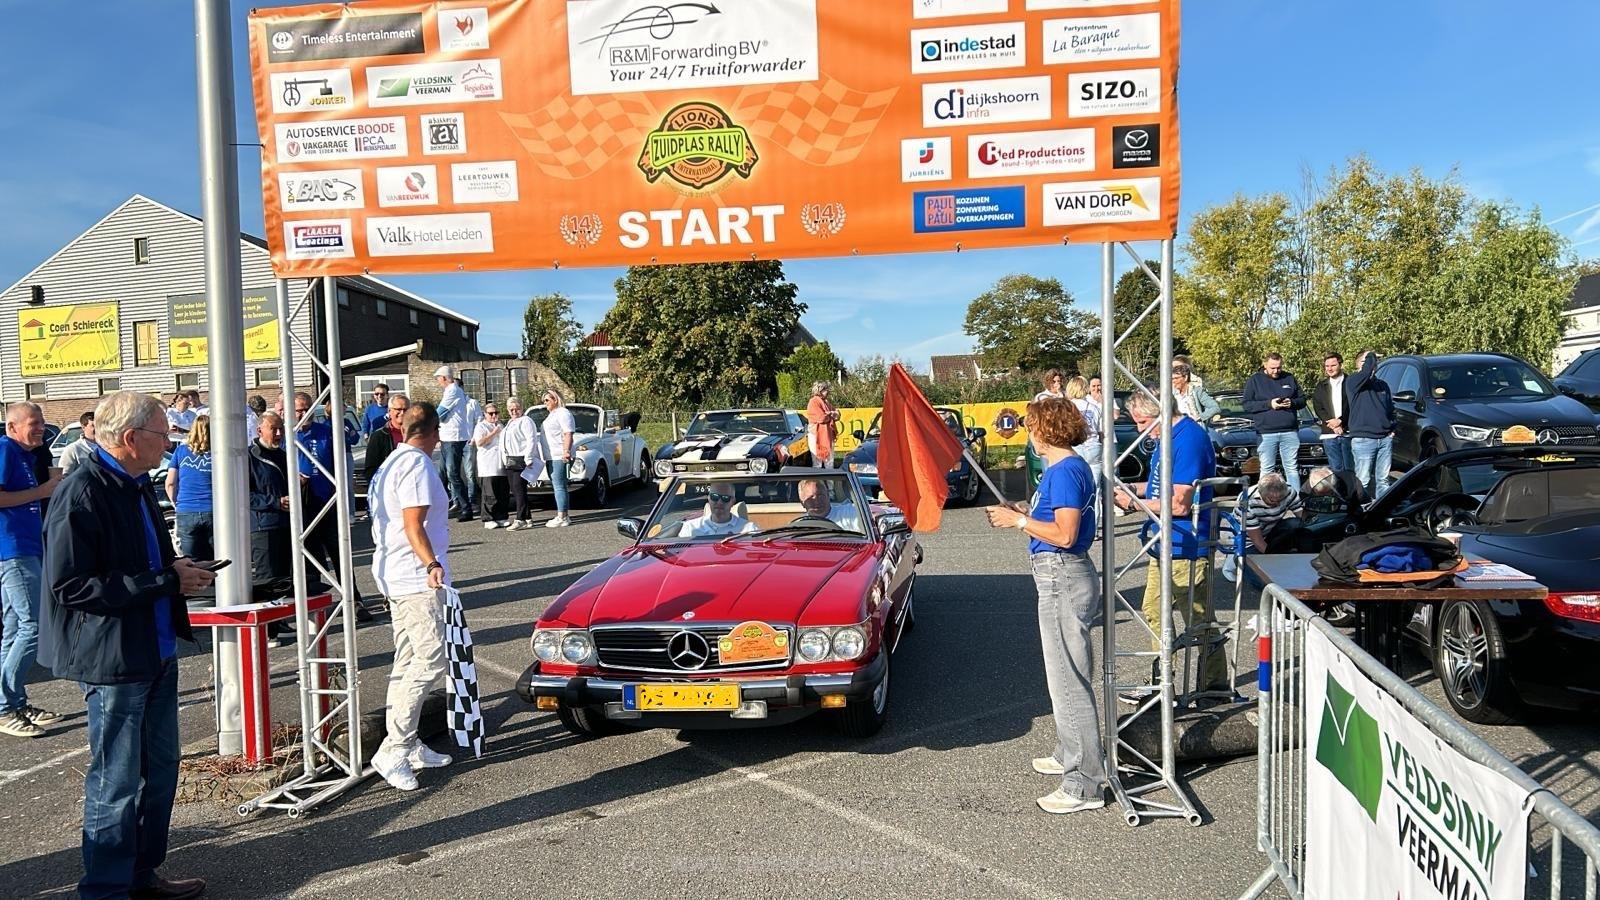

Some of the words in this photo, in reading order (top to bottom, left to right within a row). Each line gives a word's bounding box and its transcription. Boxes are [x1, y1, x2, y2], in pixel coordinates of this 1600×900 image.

[1064, 24, 1108, 33] Partycentrum
[302, 34, 344, 45] Timeless
[346, 28, 416, 41] Entertainment
[944, 34, 1016, 53] indestad
[1053, 40, 1067, 53] La
[1071, 28, 1121, 49] Baraque
[610, 46, 650, 65] R&M
[610, 69, 645, 82] Your
[650, 66, 685, 81] 24/7
[690, 58, 806, 78] Fruitforwarder
[413, 76, 453, 85] VELDSINK
[415, 86, 451, 95] VEERMAN
[310, 96, 346, 105] JONKER
[966, 92, 1039, 107] dijkshoorn
[675, 111, 716, 128] LIONS
[966, 108, 990, 118] infra
[286, 125, 356, 139] AUTOSERVICE
[357, 123, 396, 135] BOODE
[302, 140, 348, 150] VAKGARAGE
[363, 136, 386, 145] PCA
[653, 136, 705, 162] ZUIDPLAS
[708, 134, 741, 157] RALLY
[1018, 146, 1085, 158] Productions
[458, 173, 510, 181] LEERTOUWER
[677, 163, 718, 176] INTERNATIONAL
[297, 179, 338, 202] BAC
[928, 198, 953, 210] PAUL
[956, 196, 990, 204] KOZIJNEN
[1055, 196, 1086, 210] VAN
[1090, 193, 1132, 208] DORP
[811, 204, 834, 219] 14
[956, 205, 999, 213] ZONWERING
[570, 216, 591, 231] 14
[928, 213, 953, 224] PAUL
[956, 213, 1014, 223] OVERKAPPINGEN
[618, 205, 784, 248] START
[377, 227, 411, 243] Valk
[413, 230, 443, 242] Hotel
[446, 229, 483, 240] Leiden
[49, 323, 70, 333] Coen
[73, 319, 114, 330] Schiereck
[25, 357, 118, 371] www.coen-schiereck.nl
[1384, 732, 1503, 885] VELDSINK
[1397, 803, 1478, 899] VEERM
